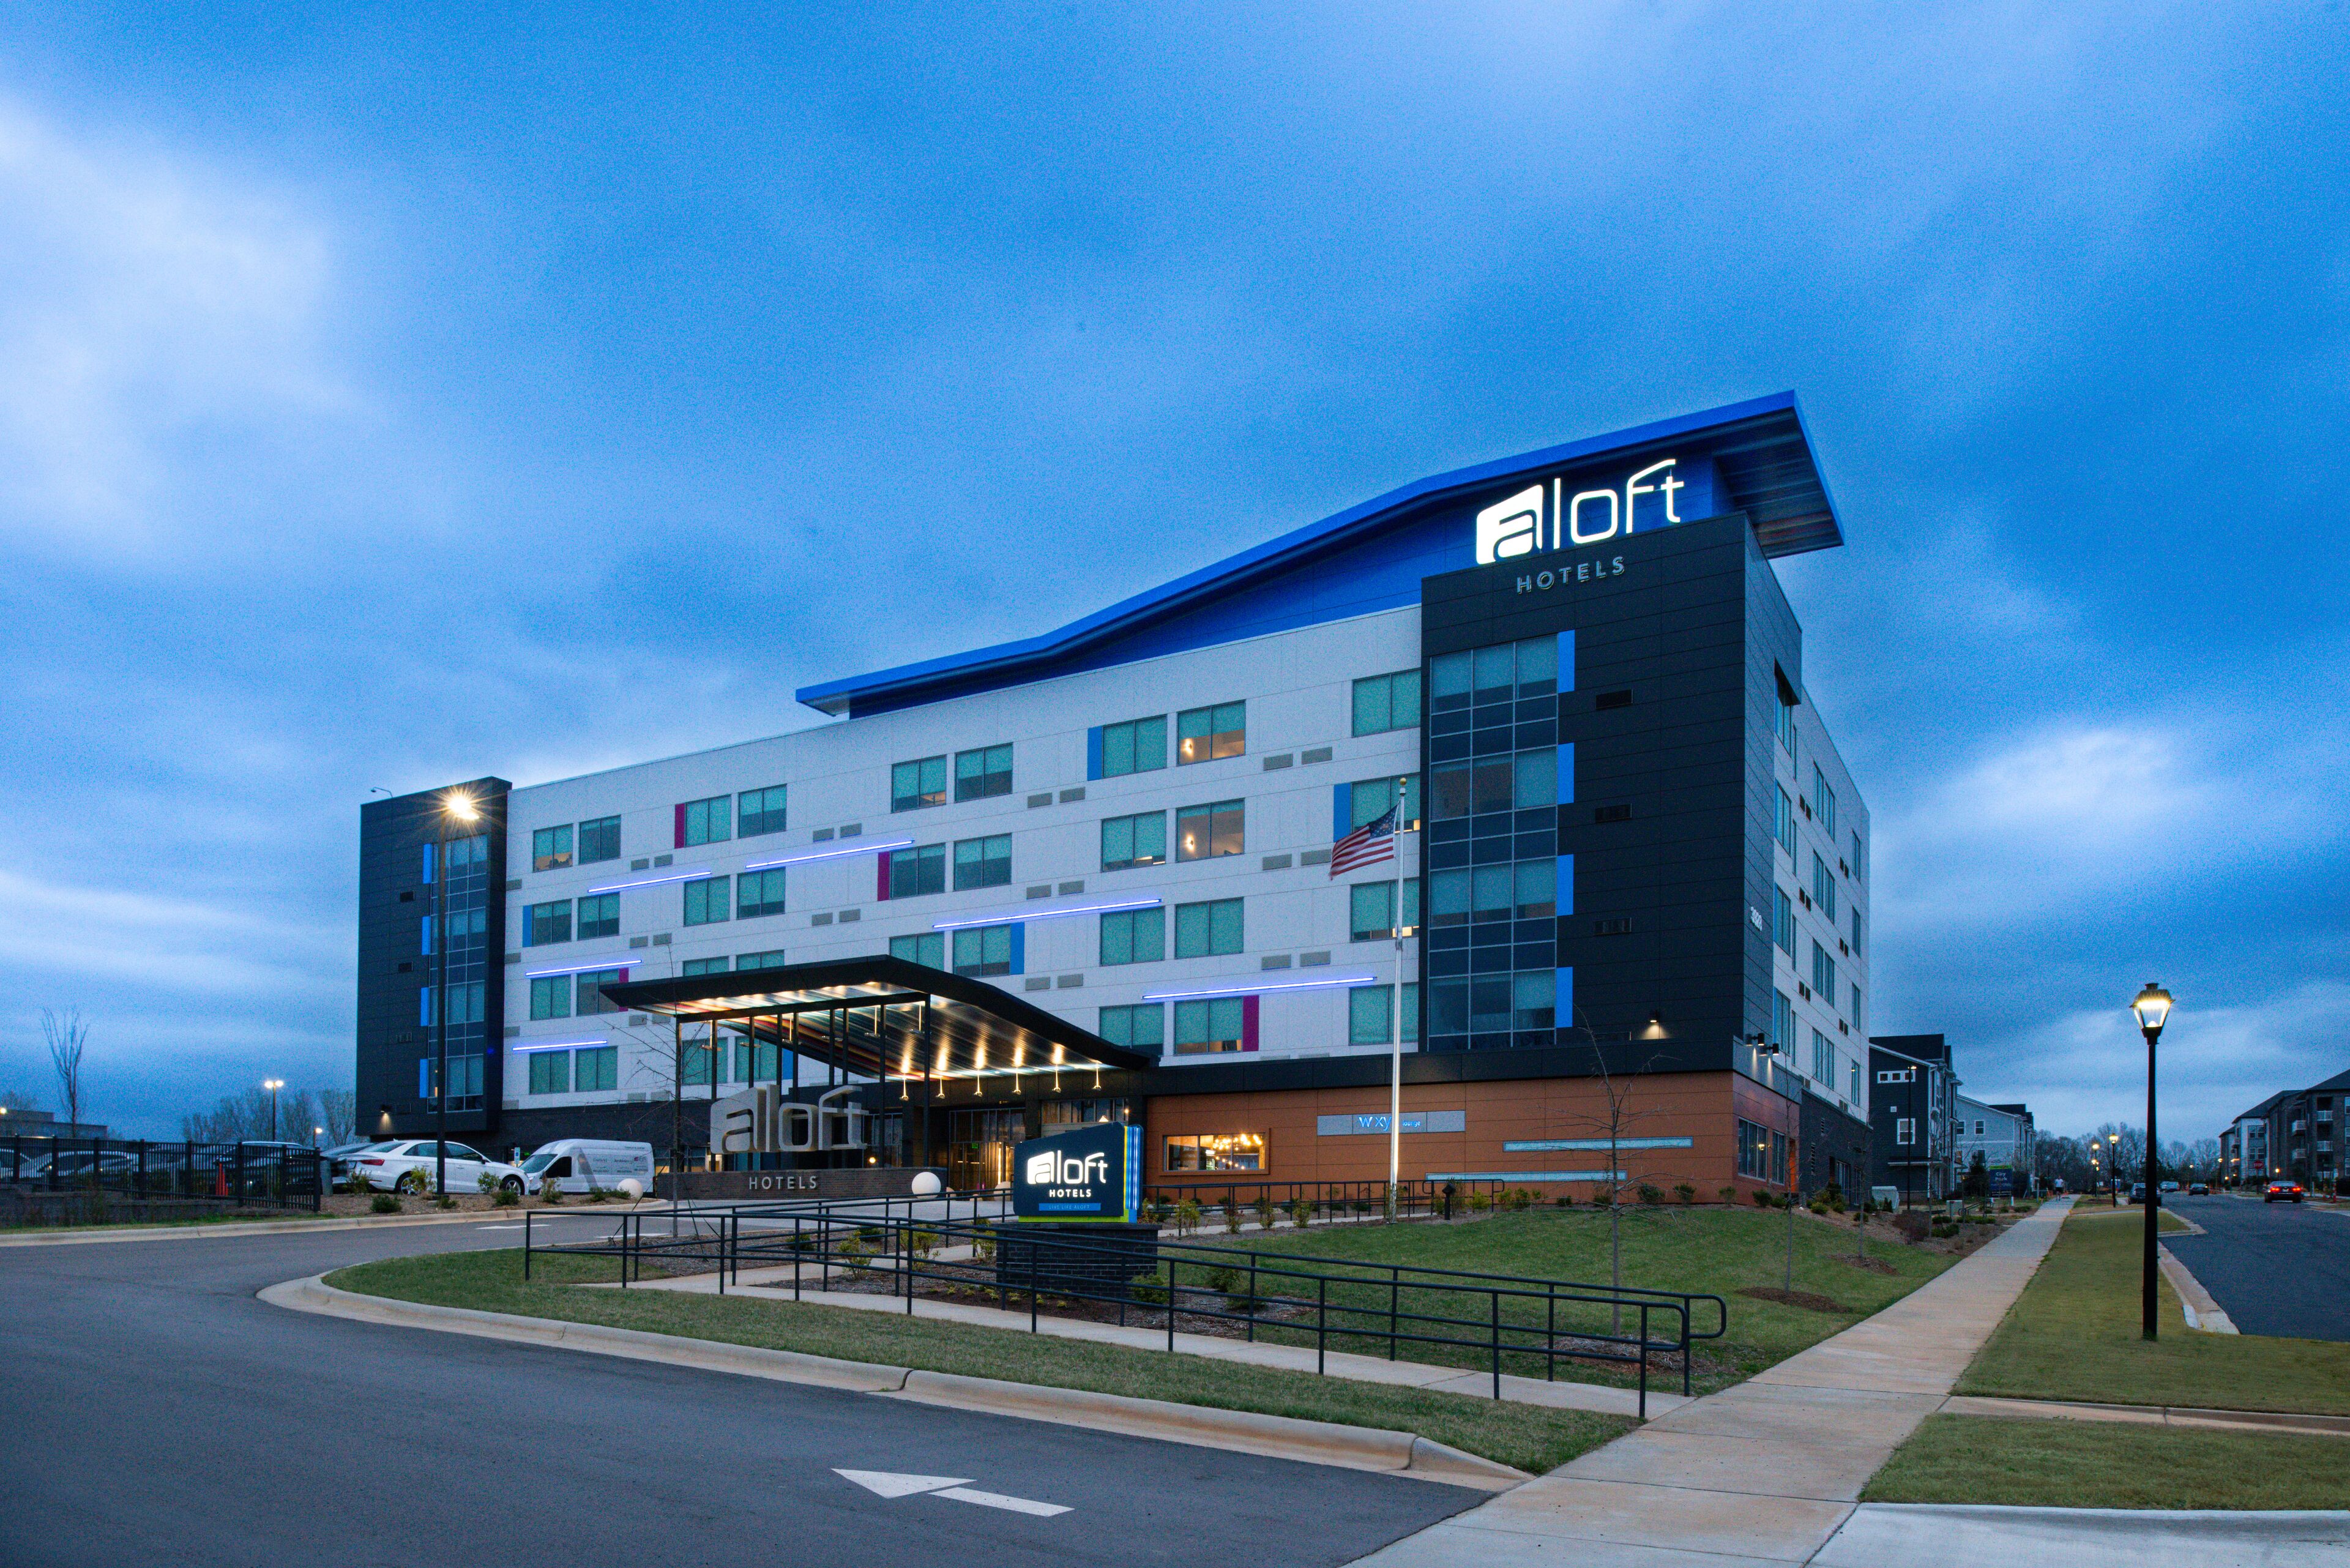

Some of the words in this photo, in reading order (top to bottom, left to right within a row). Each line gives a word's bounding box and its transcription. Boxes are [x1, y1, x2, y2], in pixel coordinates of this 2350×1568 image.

[1476, 458, 1684, 564] aloft
[1516, 556, 1625, 594] HOTELS
[711, 1084, 869, 1154] aloft
[749, 1175, 817, 1190] HOTELS
[1028, 1150, 1108, 1184] aloft
[1049, 1189, 1091, 1198] HOTELS
